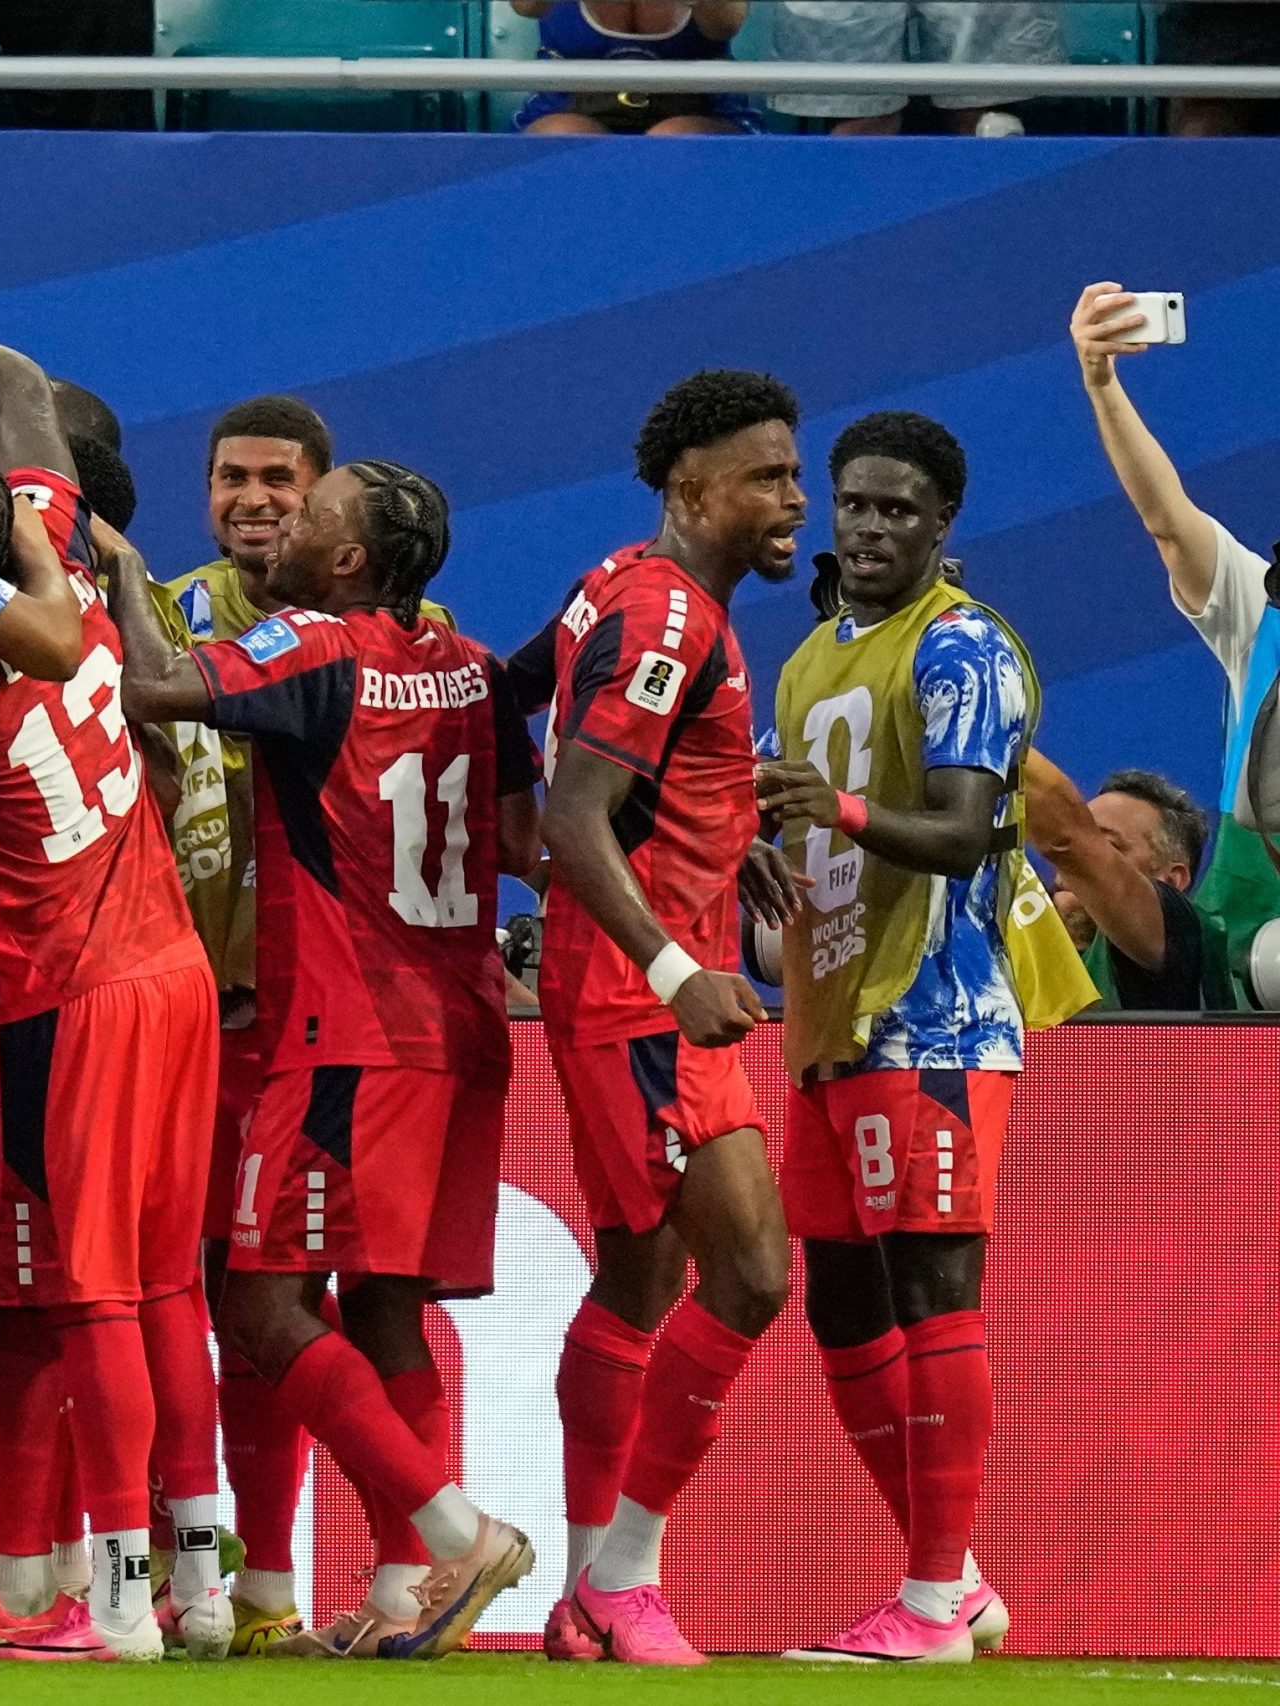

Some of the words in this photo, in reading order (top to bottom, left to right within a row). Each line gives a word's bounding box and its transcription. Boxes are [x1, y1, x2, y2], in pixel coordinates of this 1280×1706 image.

[7, 642, 142, 864] 13
[187, 766, 223, 797] IFA
[176, 818, 225, 856] ORLD
[378, 752, 479, 928] 11
[829, 861, 857, 891] FIFA
[854, 1113, 896, 1189] 8
[233, 1152, 263, 1227] 1
